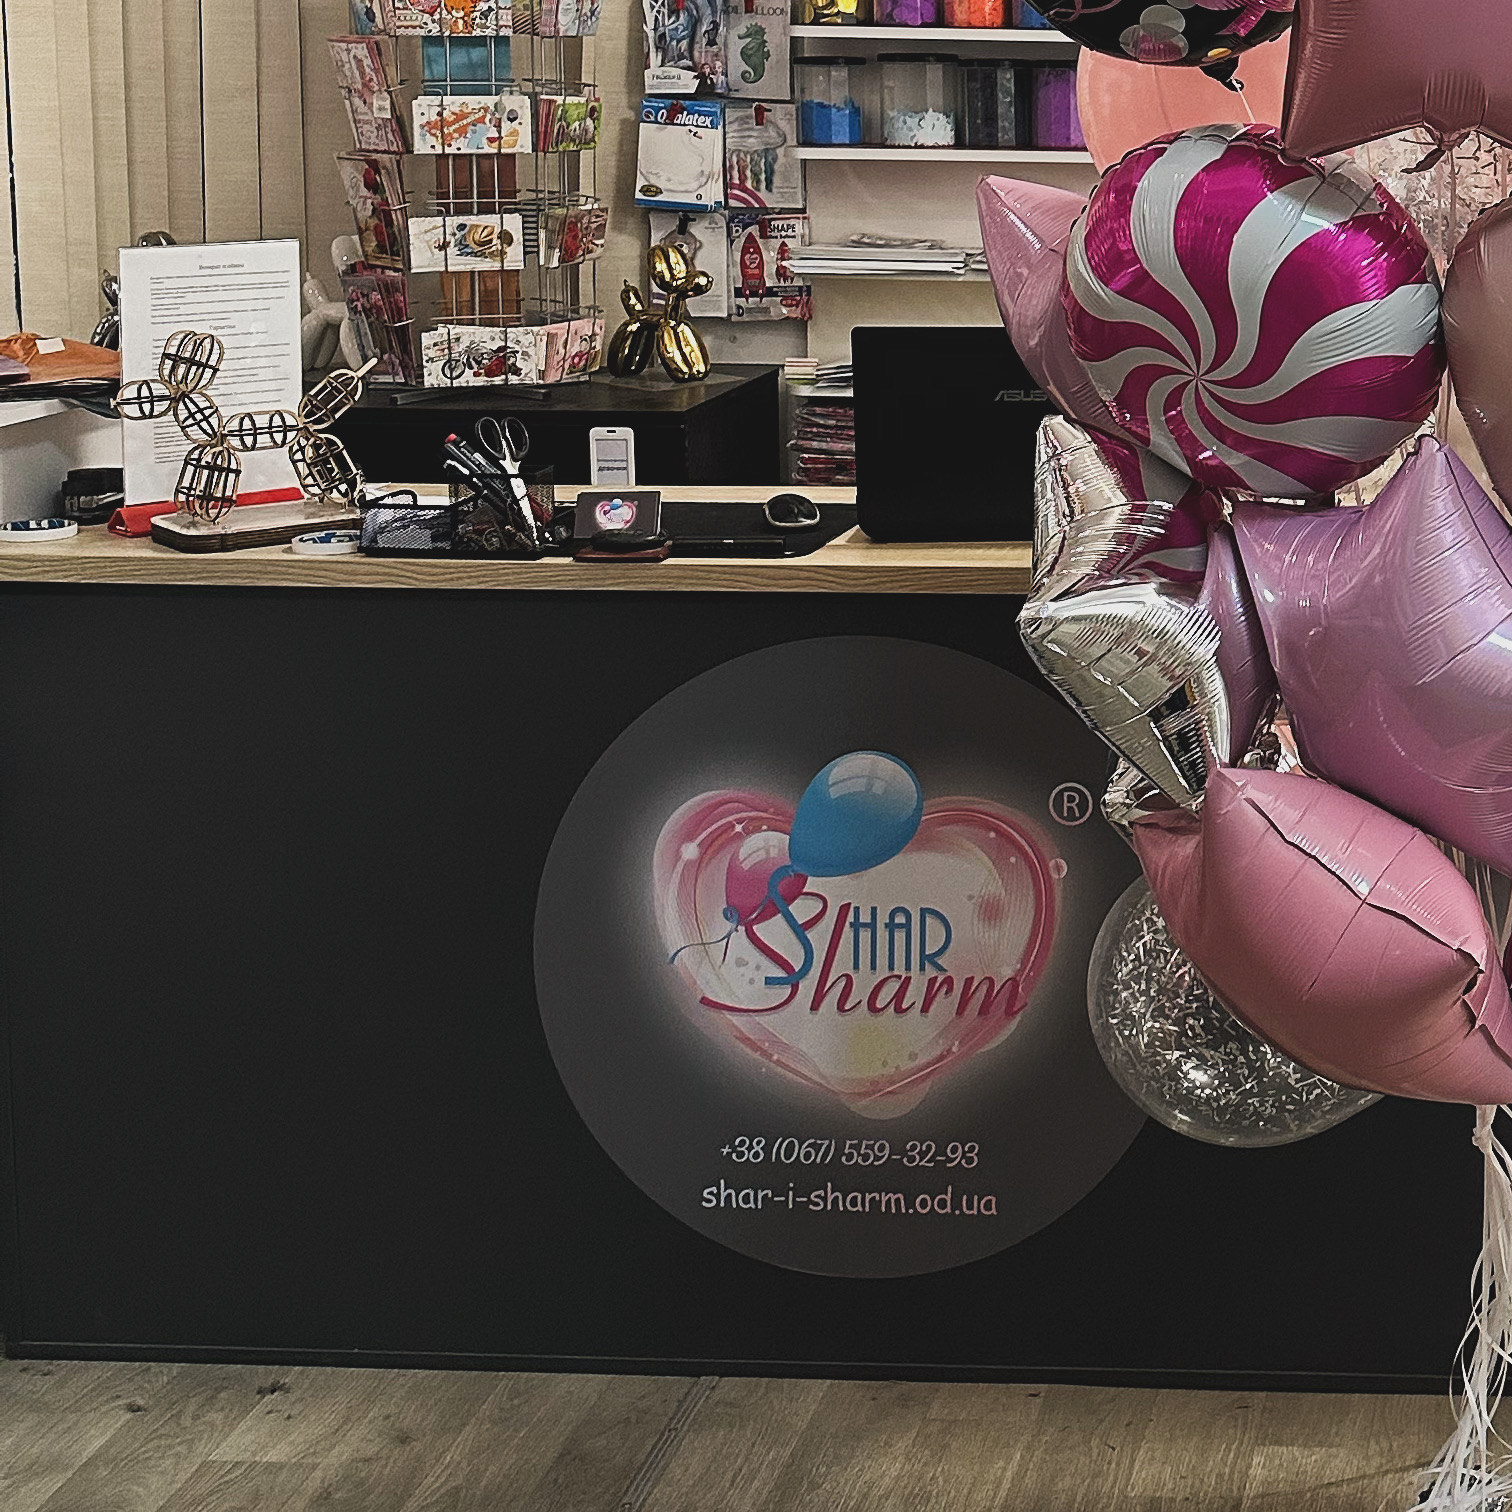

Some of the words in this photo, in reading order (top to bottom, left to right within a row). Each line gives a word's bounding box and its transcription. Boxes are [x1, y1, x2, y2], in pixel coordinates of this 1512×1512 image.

[994, 390, 1048, 402] ASUS
[699, 890, 1029, 1018] Sharm
[720, 1136, 766, 1164] +38
[771, 1137, 836, 1164] (067)
[841, 1140, 980, 1169] 559-32-93
[701, 1178, 998, 1216] shar-i-sharm.od.ua
